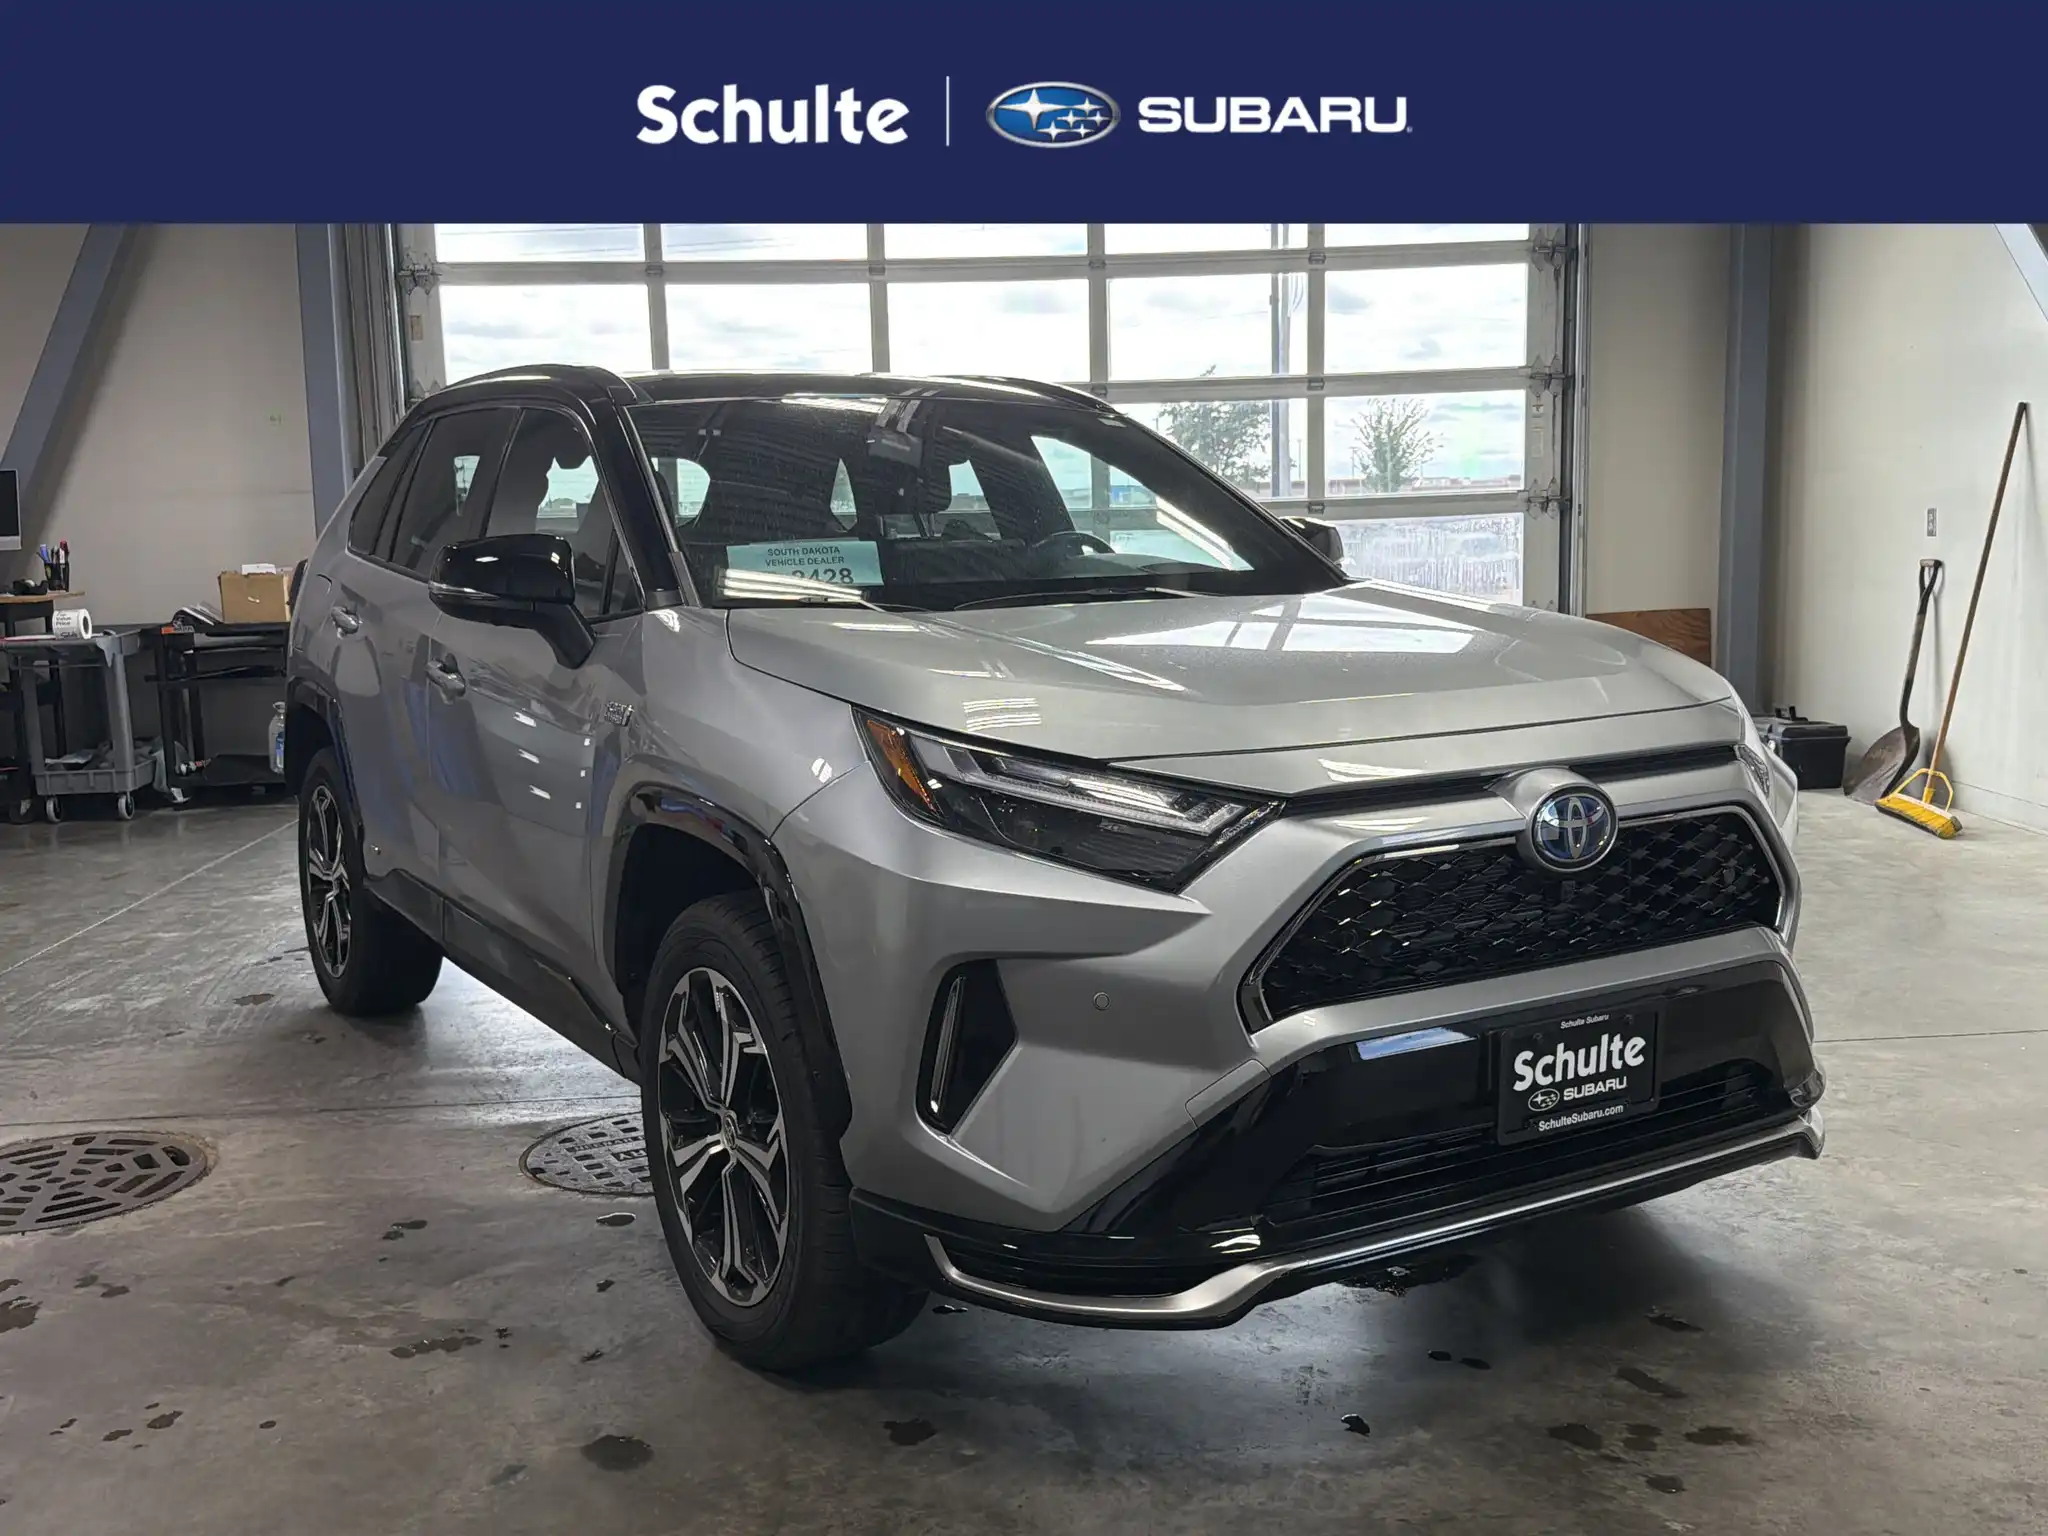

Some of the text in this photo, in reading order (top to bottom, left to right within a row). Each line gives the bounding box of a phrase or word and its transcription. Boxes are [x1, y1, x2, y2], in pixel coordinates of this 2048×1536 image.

[766, 556, 844, 566] VEHICLE DEALER
[767, 546, 840, 556] SOUTH DAKOTA
[1560, 1014, 1610, 1029] Schulte Subaru
[1513, 1033, 1646, 1091] Schulte
[1563, 1076, 1627, 1101] SUBARU
[1538, 1104, 1624, 1131] SchulteSubaru.com
